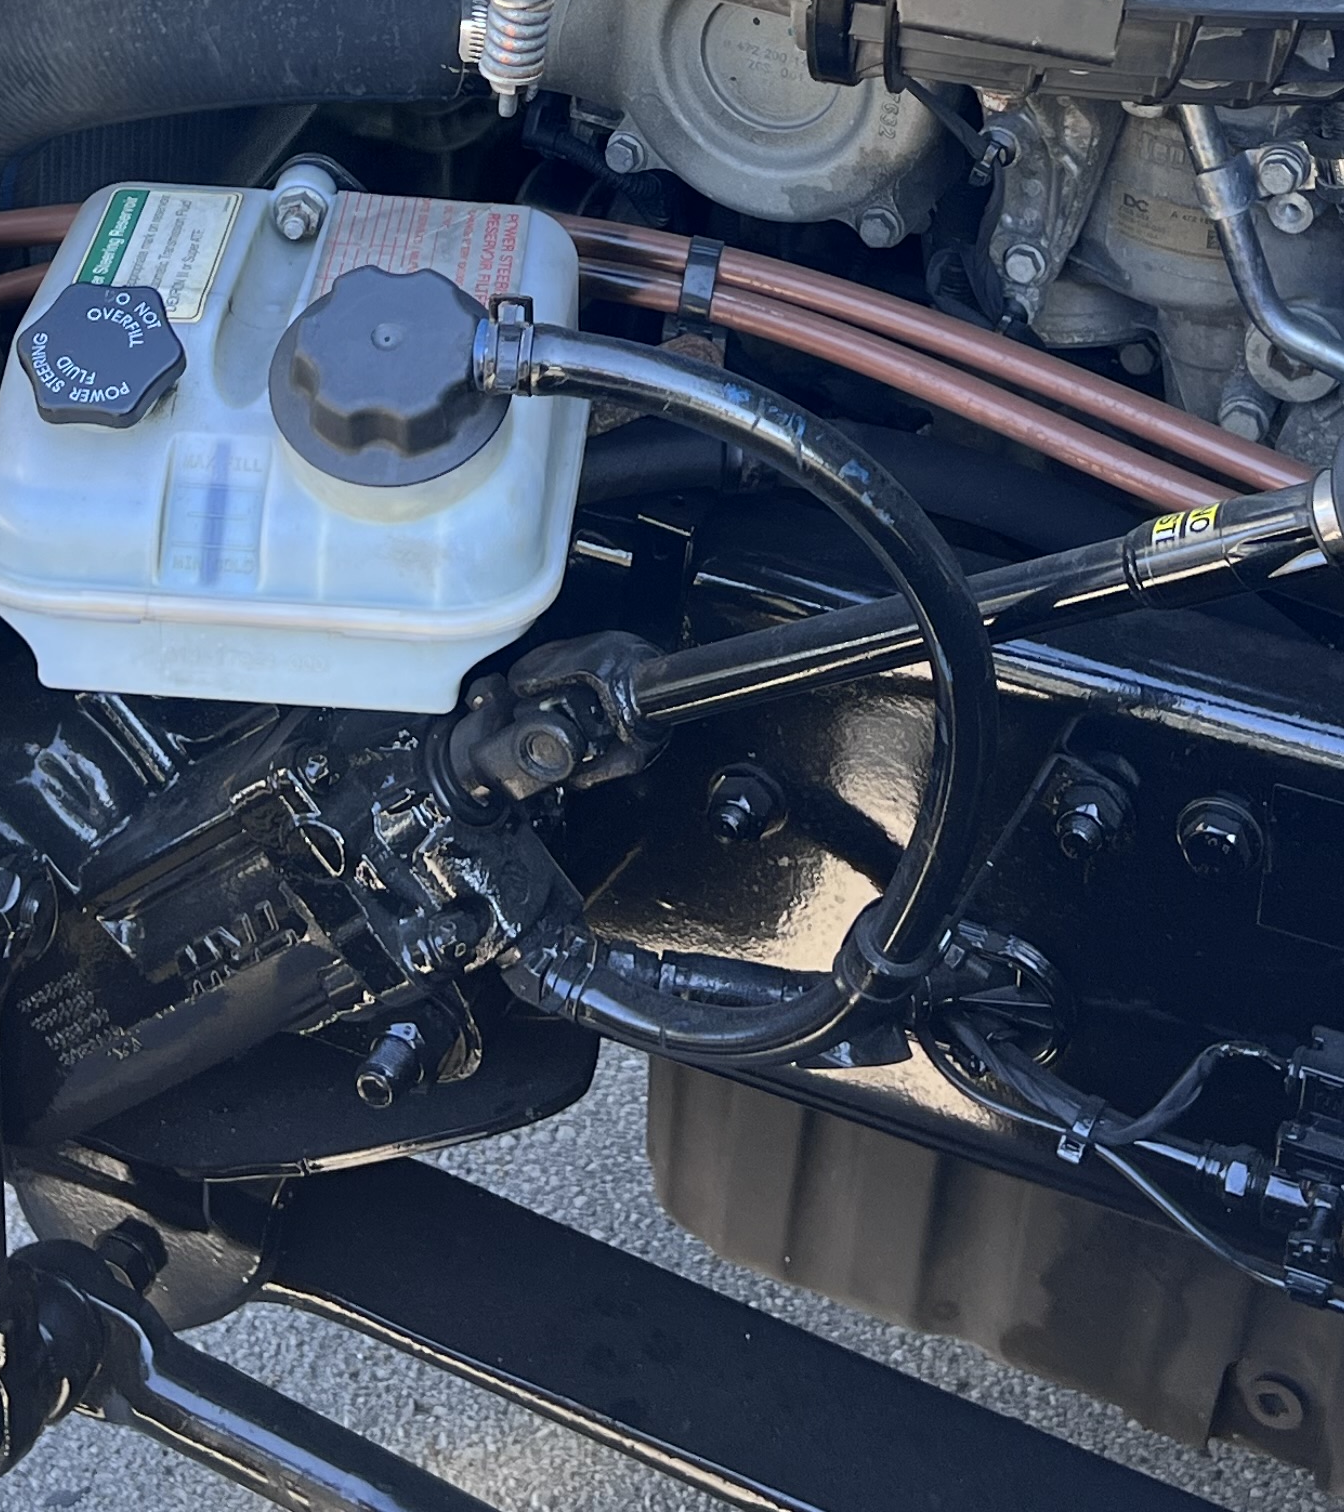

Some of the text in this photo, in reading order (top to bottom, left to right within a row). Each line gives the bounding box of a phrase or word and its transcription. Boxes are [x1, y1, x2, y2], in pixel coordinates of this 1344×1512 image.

[765, 49, 787, 62] 200
[176, 199, 192, 216] Fluid
[1124, 193, 1149, 213] DC
[91, 196, 138, 284] er Steering Reservoir
[479, 212, 501, 270] RESERVOIR
[500, 213, 519, 252] POWER
[86, 308, 145, 348] OVERFILL
[134, 301, 161, 329] NOT
[31, 332, 130, 403] POWER STEERING
[56, 356, 96, 385] FLUID
